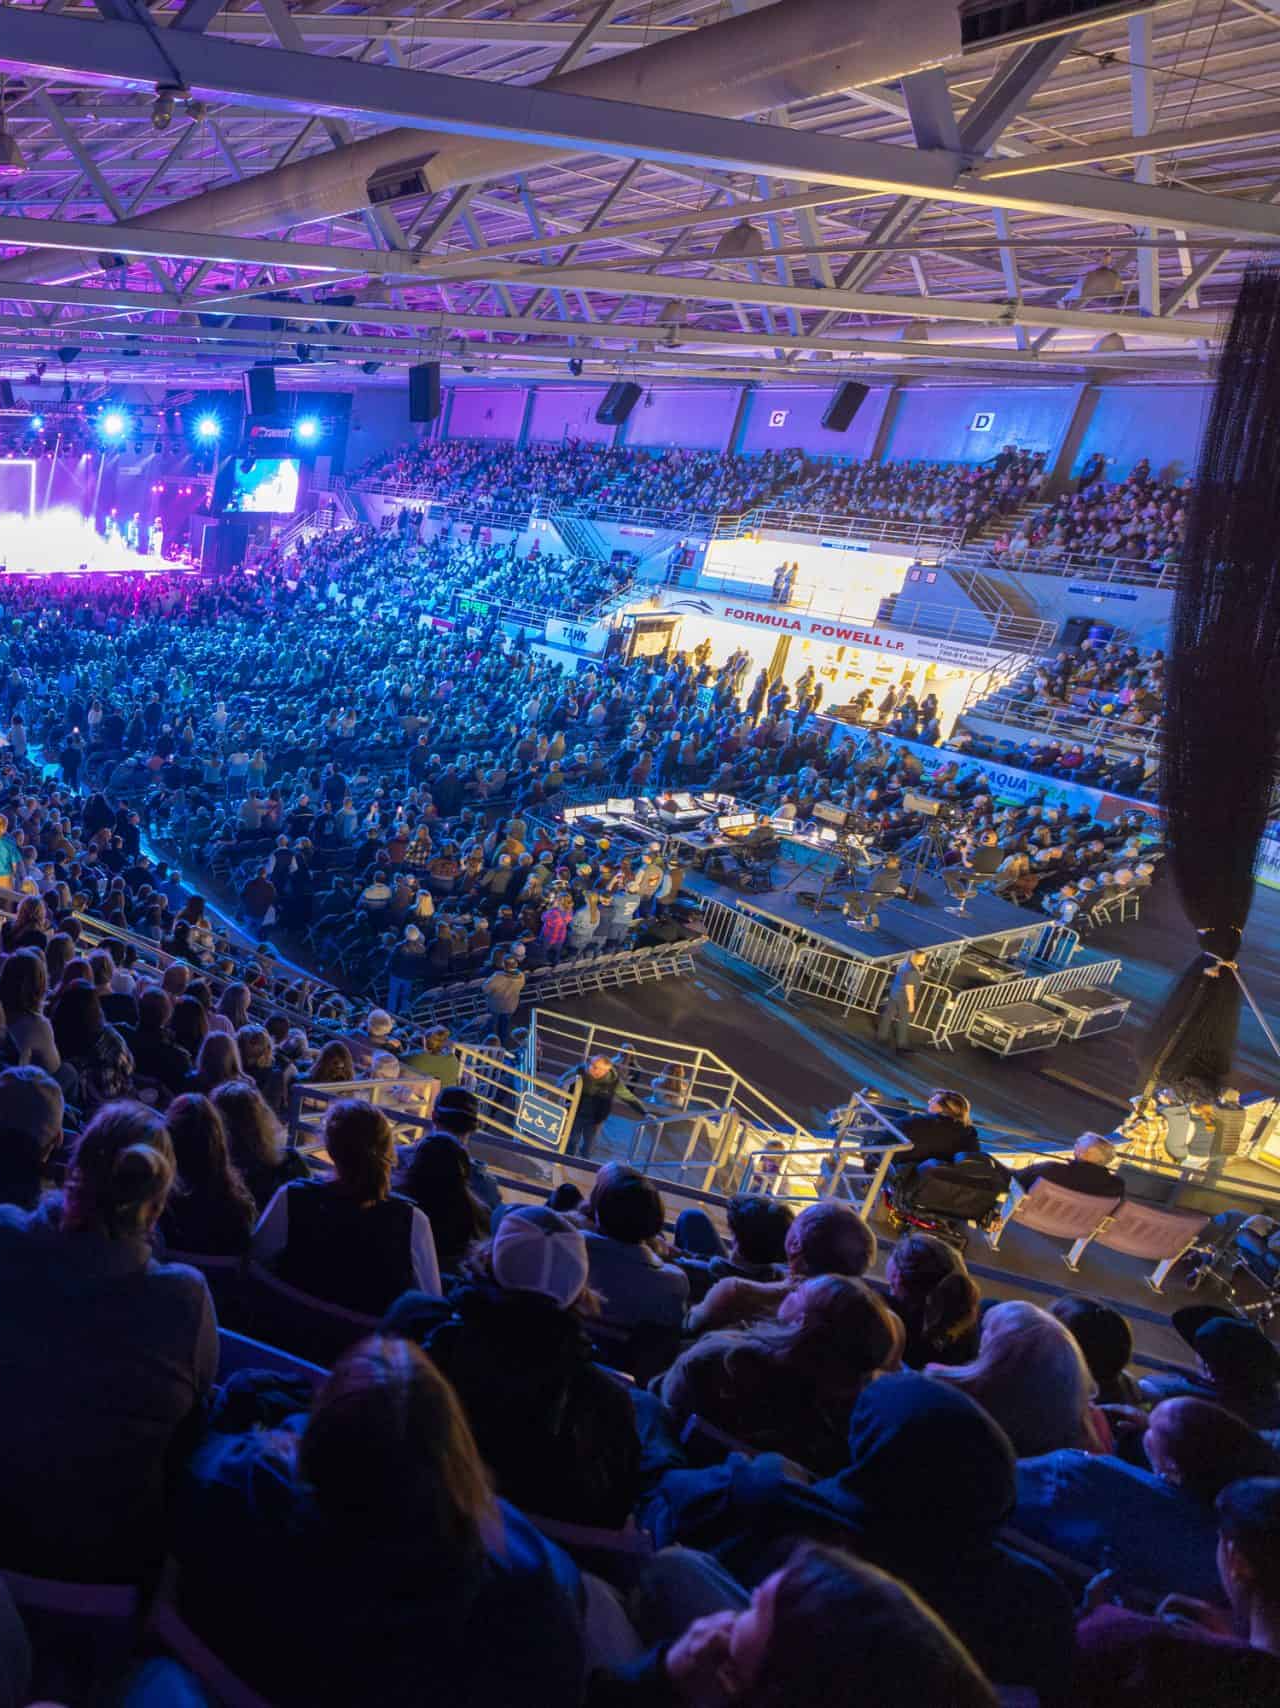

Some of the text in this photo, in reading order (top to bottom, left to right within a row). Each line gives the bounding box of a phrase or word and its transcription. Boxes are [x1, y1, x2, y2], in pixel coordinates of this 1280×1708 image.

[772, 412, 783, 424] C
[975, 415, 990, 428] D
[724, 607, 904, 651] FORMULA POWELL L.P.
[988, 771, 1067, 801] AQUATRA
